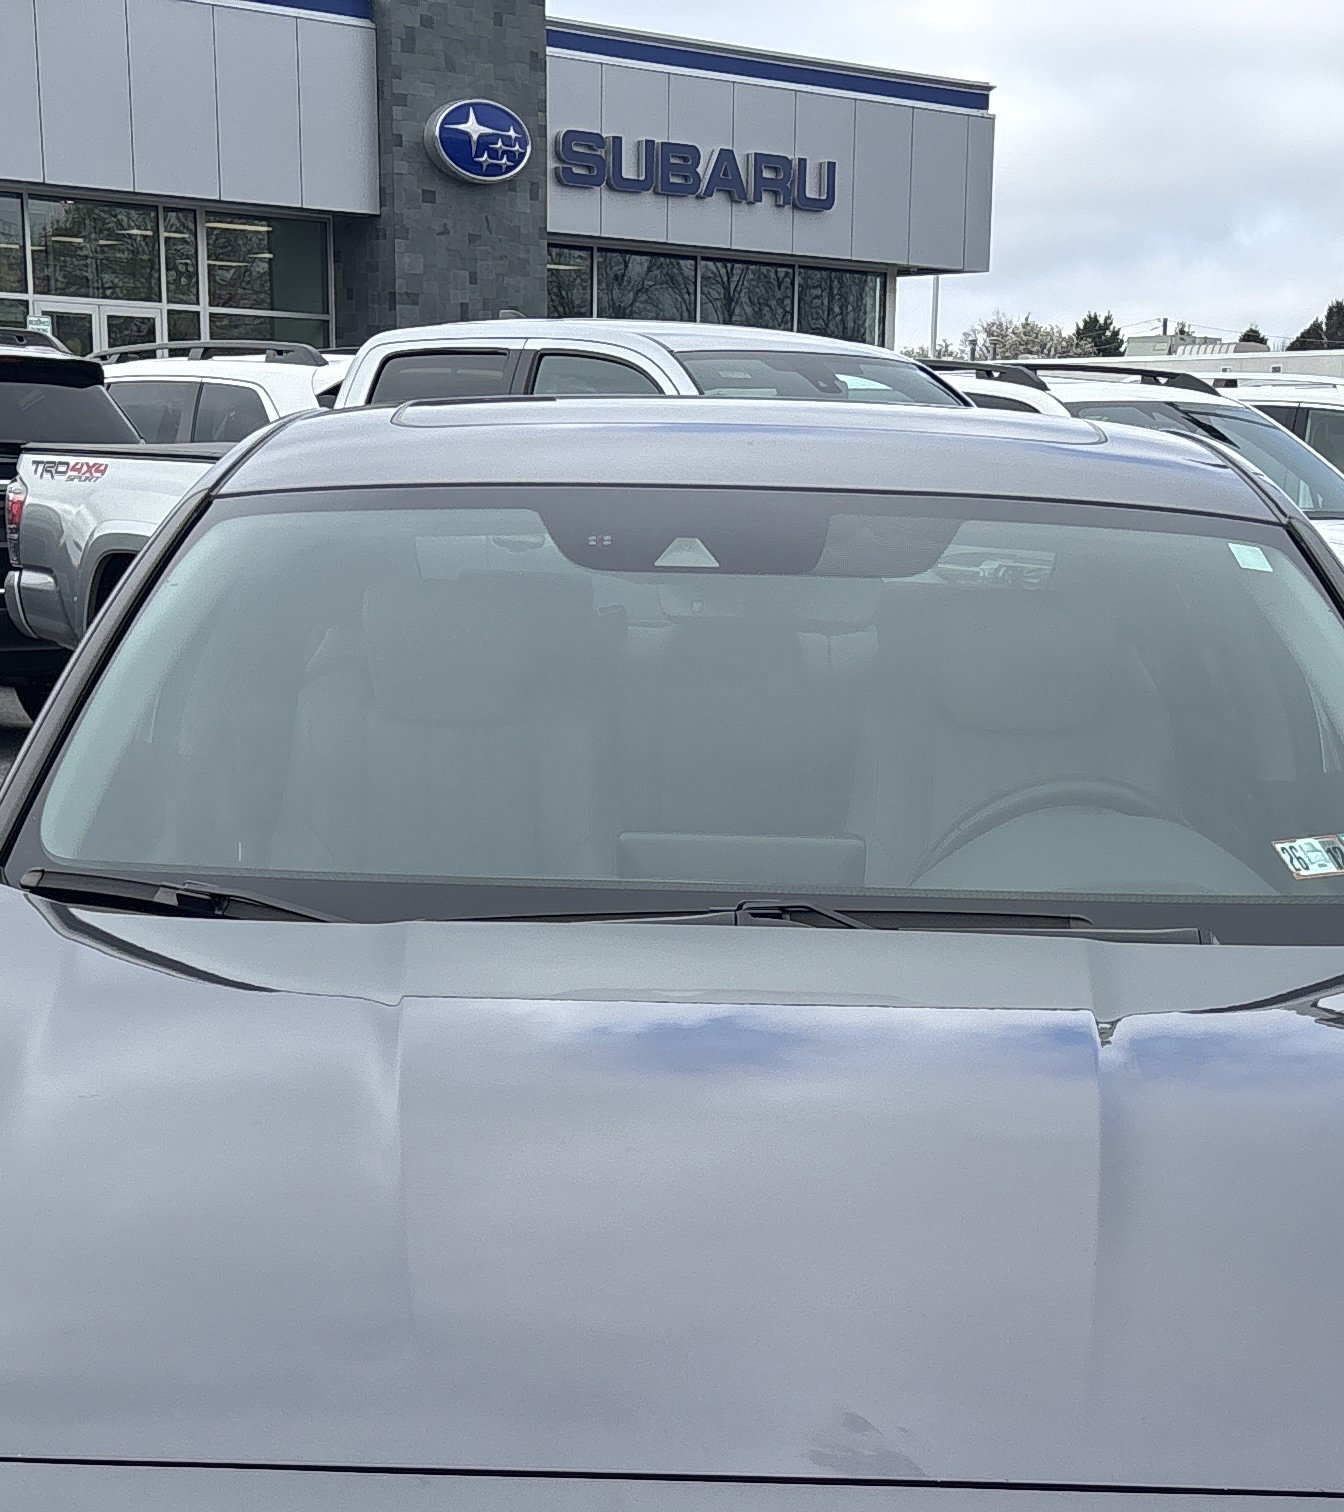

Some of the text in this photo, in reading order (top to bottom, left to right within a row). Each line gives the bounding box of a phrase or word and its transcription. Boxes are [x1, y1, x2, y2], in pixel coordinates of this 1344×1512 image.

[558, 129, 837, 211] SUBARU
[32, 460, 70, 480] TRD
[1280, 845, 1310, 872] 26
